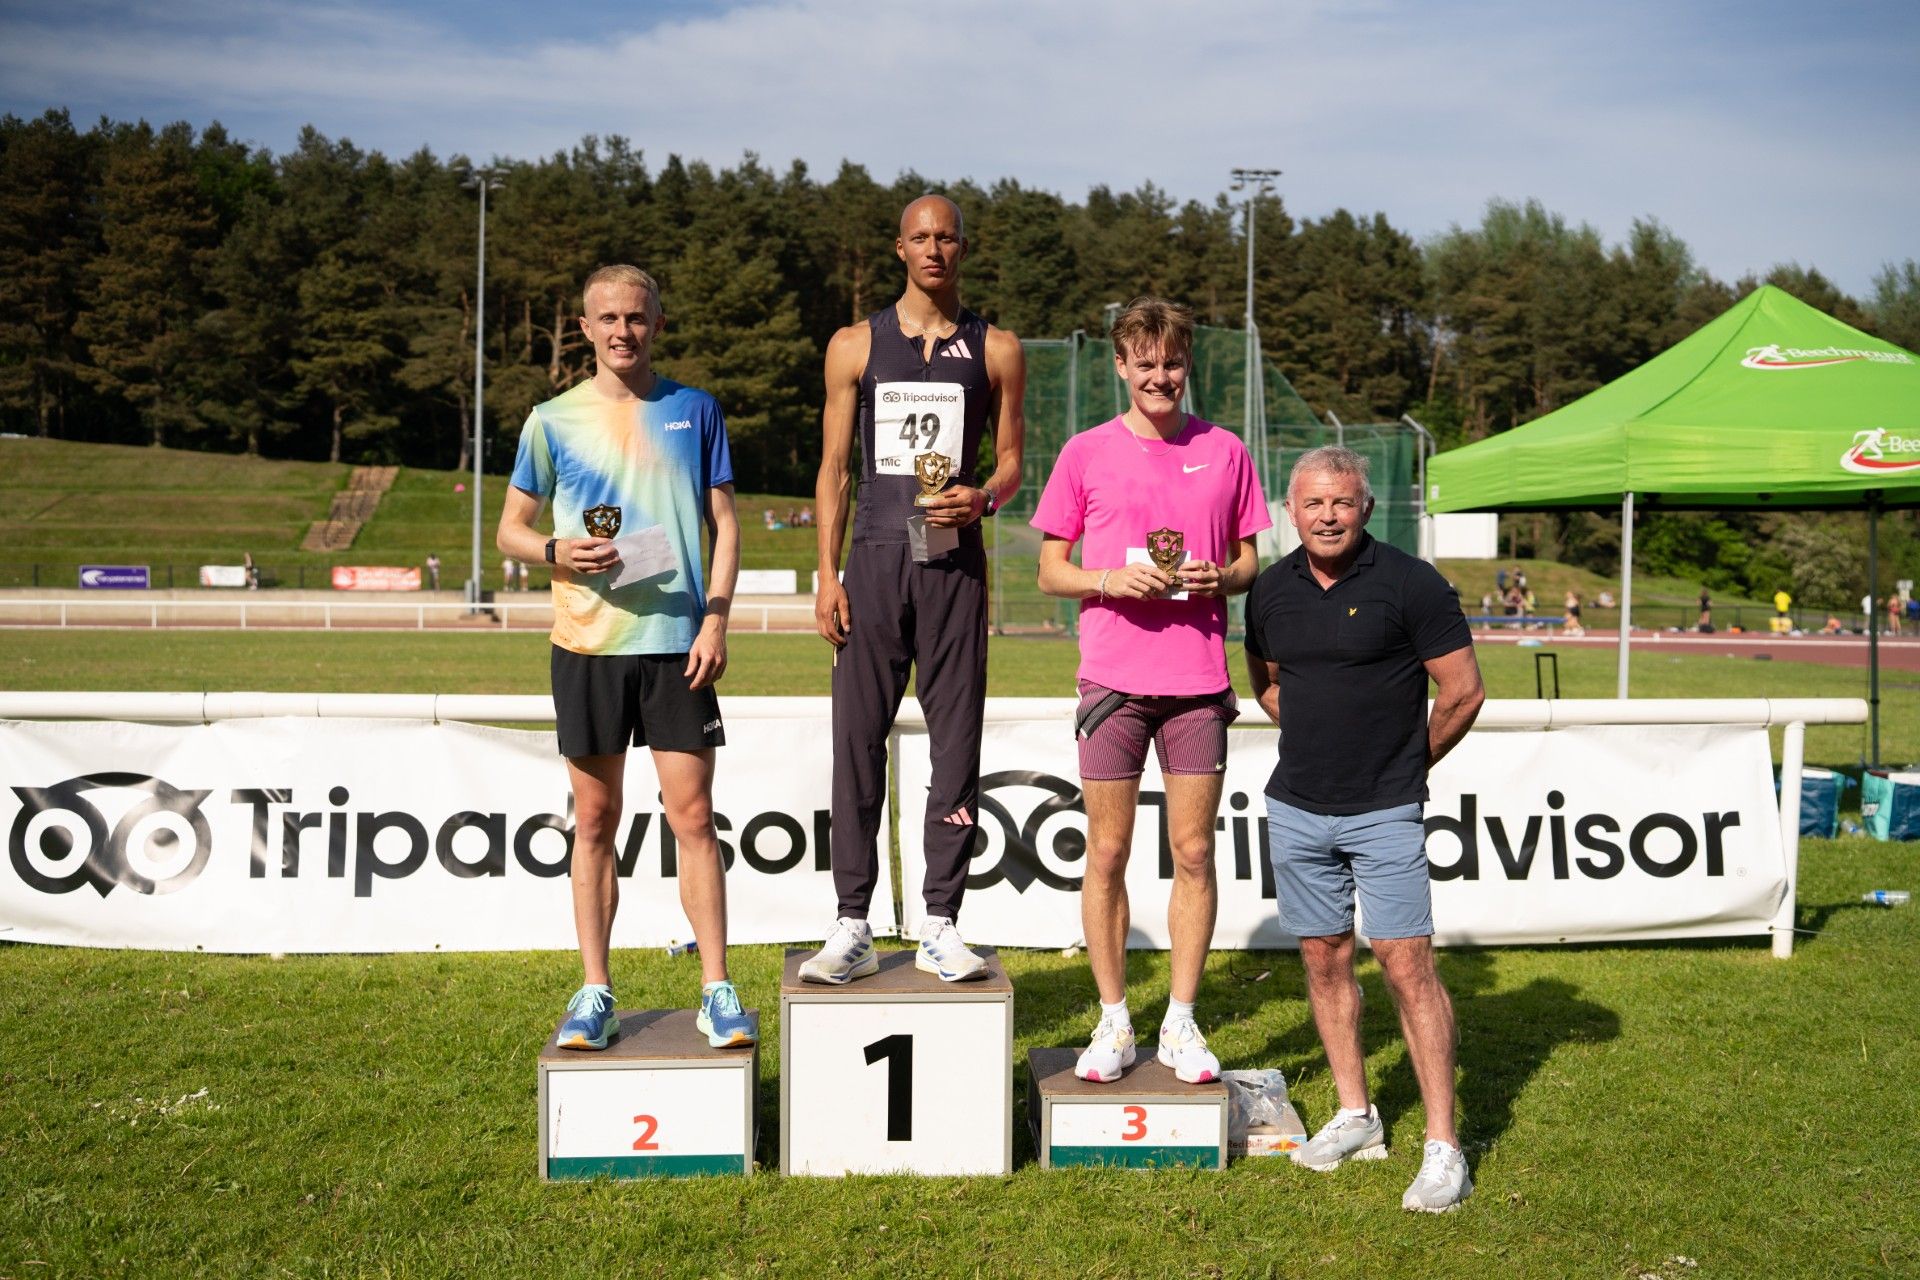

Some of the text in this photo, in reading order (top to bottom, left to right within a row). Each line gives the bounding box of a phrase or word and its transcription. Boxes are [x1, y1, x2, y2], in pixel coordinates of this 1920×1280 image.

[903, 393, 959, 403] Tripadvisor
[664, 420, 692, 431] HOKA
[899, 413, 941, 450] 49
[703, 718, 722, 734] HOKA
[864, 1035, 913, 1141] 1
[632, 1114, 659, 1150] 2
[1122, 1105, 1148, 1141] 3
